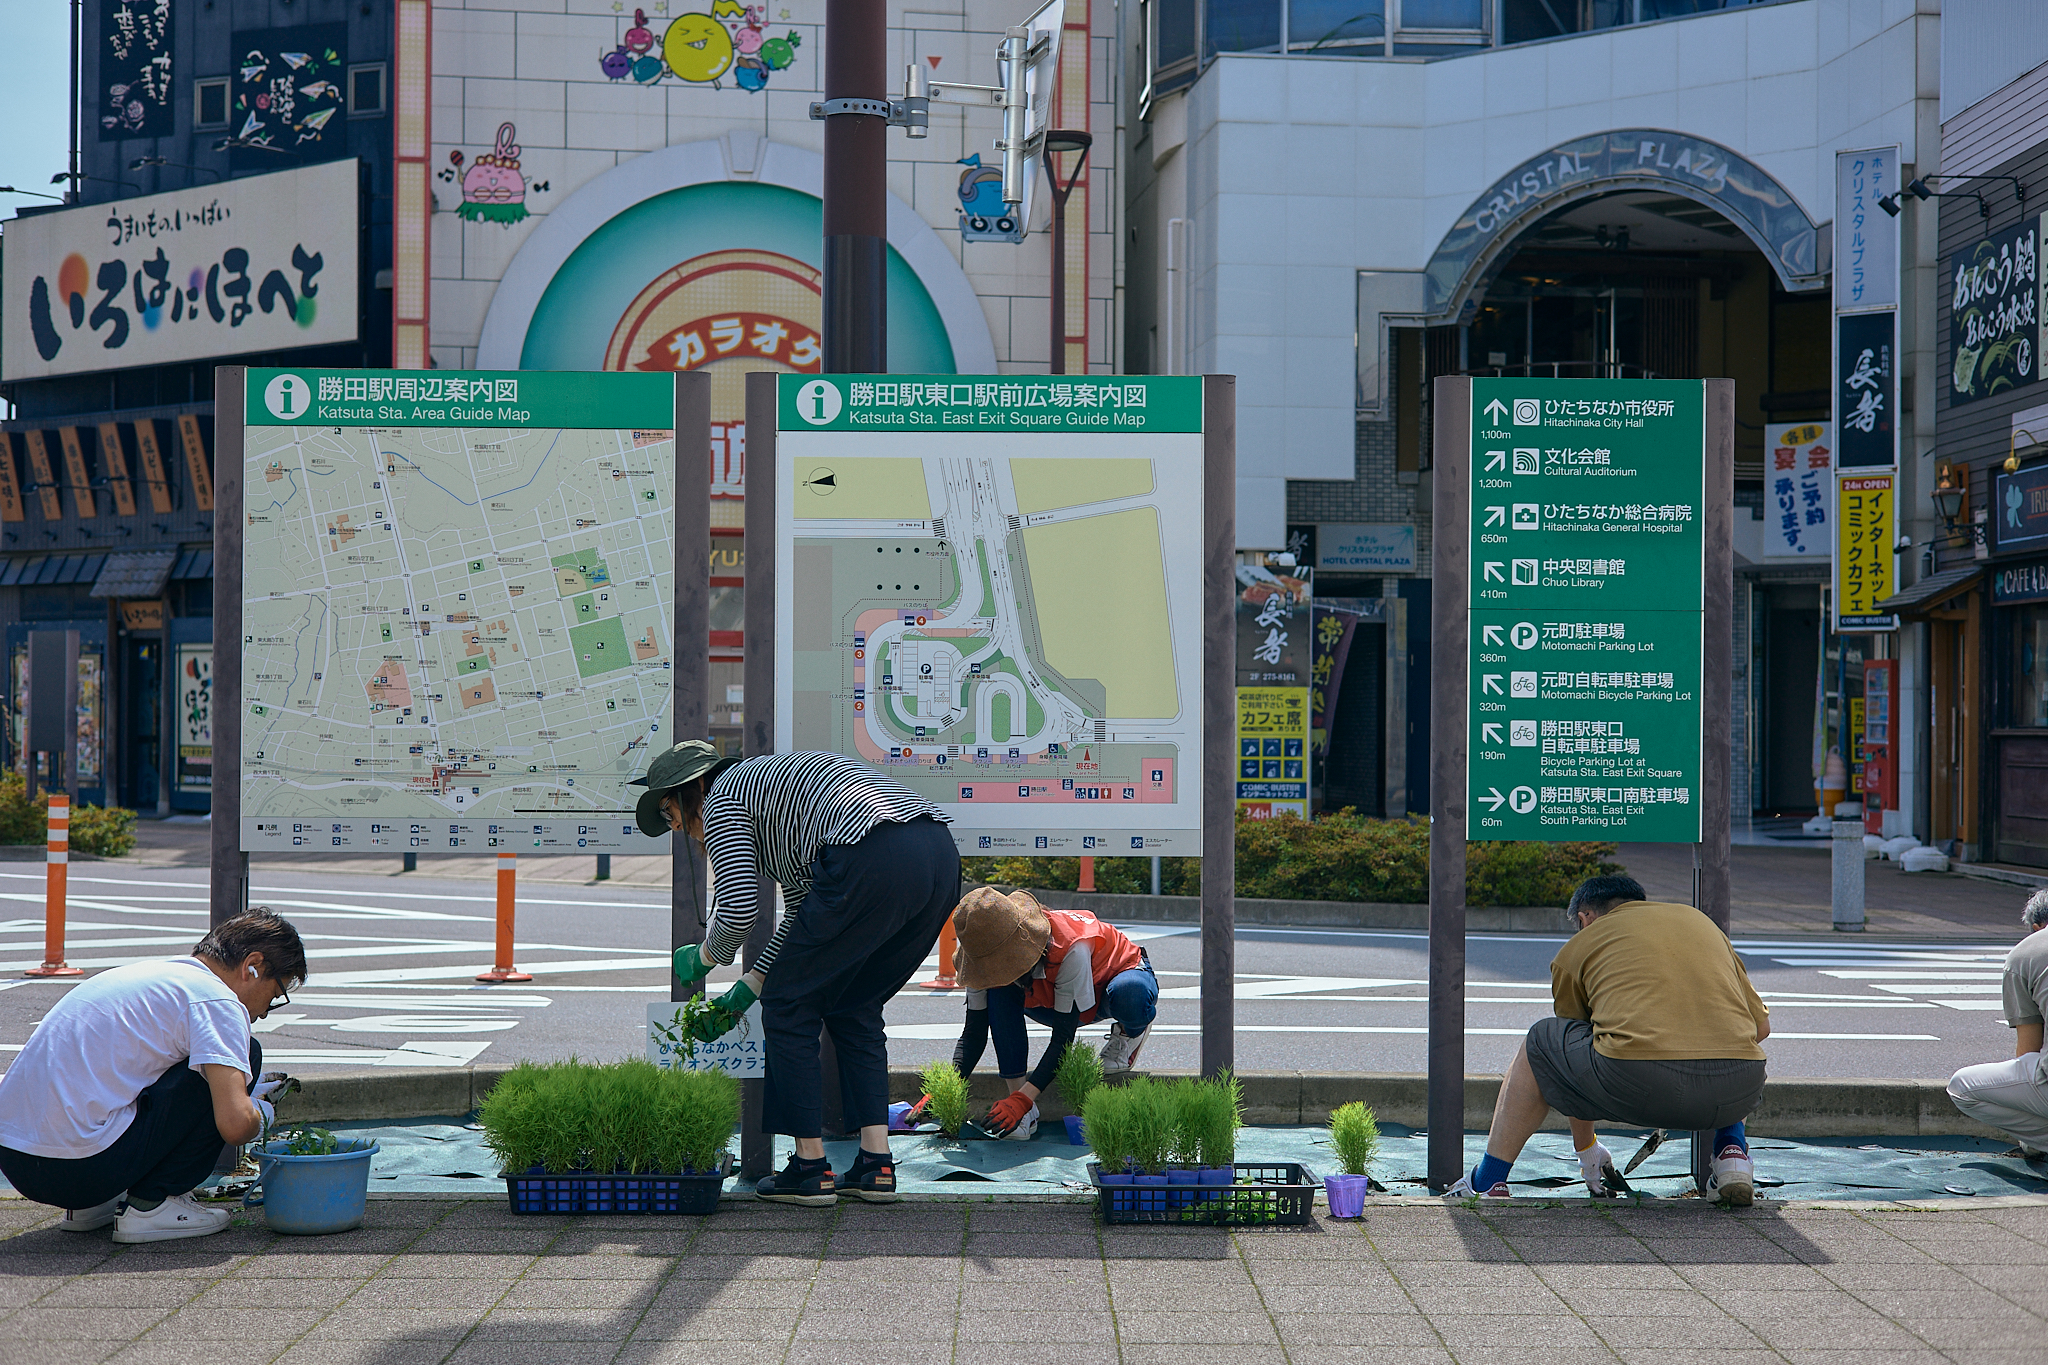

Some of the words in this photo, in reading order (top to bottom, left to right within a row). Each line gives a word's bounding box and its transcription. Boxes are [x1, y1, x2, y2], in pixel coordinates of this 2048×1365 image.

[1872, 157, 1883, 200] ホテル
[1476, 152, 1589, 233] CRYSTAL
[1638, 141, 1728, 189] PLAZA
[1852, 160, 1865, 301] クリスタルプラザ
[30, 243, 323, 361] いろはにほへと
[668, 317, 821, 369] カラオケ
[317, 377, 519, 403] 勝田駅周辺案内図
[849, 383, 1147, 408] 勝田駅東口駅前広場案内図
[317, 407, 374, 422] Katsuta
[378, 407, 408, 422] Sta.
[411, 407, 446, 422] Area
[450, 407, 494, 422] Guide
[497, 407, 530, 422] Map
[1544, 400, 1674, 417] ひたちなか市役所
[849, 411, 905, 427] Katsuta
[909, 411, 938, 427] Sta.
[942, 411, 975, 427] East
[978, 411, 1006, 427] Exit
[1010, 411, 1062, 427] Square
[1065, 411, 1111, 427] Guide
[1114, 411, 1146, 427] Map
[1544, 418, 1601, 429] Hitachinaka
[1603, 418, 1626, 429] City
[1627, 418, 1644, 429] Hall
[1480, 430, 1511, 440] 1,100m
[1786, 426, 1817, 446] 各種
[1544, 448, 1611, 465] 文化会館
[1774, 445, 1830, 471] 宴会
[1544, 466, 1581, 477] Cultural
[1584, 466, 1637, 477] Auditorium
[1478, 479, 1512, 489] 1,200m
[1863, 480, 1889, 489] OPEN
[1801, 470, 1825, 526] ご予約
[1543, 504, 1692, 521] ひたちなか総合病院
[1542, 522, 1600, 534] Hitachinaka
[1602, 522, 1640, 534] General
[1642, 522, 1683, 534] Hospital
[1481, 534, 1508, 544] 650m
[1338, 546, 1394, 554] クリスタルプラザ
[1849, 496, 1863, 611] コミックカフェ
[1542, 559, 1626, 576] 中央図書館
[1542, 578, 1568, 590] Chuo
[1571, 578, 1605, 590] Library
[2004, 568, 2029, 594] CAFE
[1480, 590, 1507, 599] 410m
[1542, 623, 1626, 640] 元町駐車場
[1541, 641, 1597, 653] Motomachi
[1598, 641, 1636, 653] Parking
[1638, 641, 1654, 653] Lot
[1479, 653, 1507, 663] 360m
[1541, 672, 1674, 689] 元町自転車駐車場
[1541, 690, 1596, 702] Motomachi
[1598, 690, 1634, 702] Bicycle
[1635, 690, 1674, 702] Parking
[1675, 690, 1692, 702] Lot
[1479, 703, 1506, 712] 320m
[1242, 711, 1301, 725] カフェ席
[1540, 720, 1624, 737] 勝田駅東口
[1542, 739, 1640, 755] 自転車駐車場
[1479, 751, 1506, 760] 190m
[1540, 757, 1576, 768] Bicycle
[1578, 757, 1616, 768] Parking
[1617, 757, 1633, 768] Lot
[1635, 757, 1646, 768] at
[1540, 768, 1577, 779] Katsuta
[1580, 768, 1600, 779] Sta.
[1602, 768, 1624, 779] East
[1626, 768, 1645, 779] Exit
[1647, 768, 1682, 779] Square
[1540, 787, 1690, 804] 勝田駅東口南駐車場
[1540, 805, 1578, 816] Katsuta
[1580, 805, 1600, 816] Sta.
[1602, 805, 1624, 816] East
[1626, 805, 1645, 816] Exit
[1481, 818, 1503, 827] 60m
[1540, 816, 1569, 827] South
[1571, 816, 1609, 827] Parking
[1611, 816, 1627, 827] Lot
